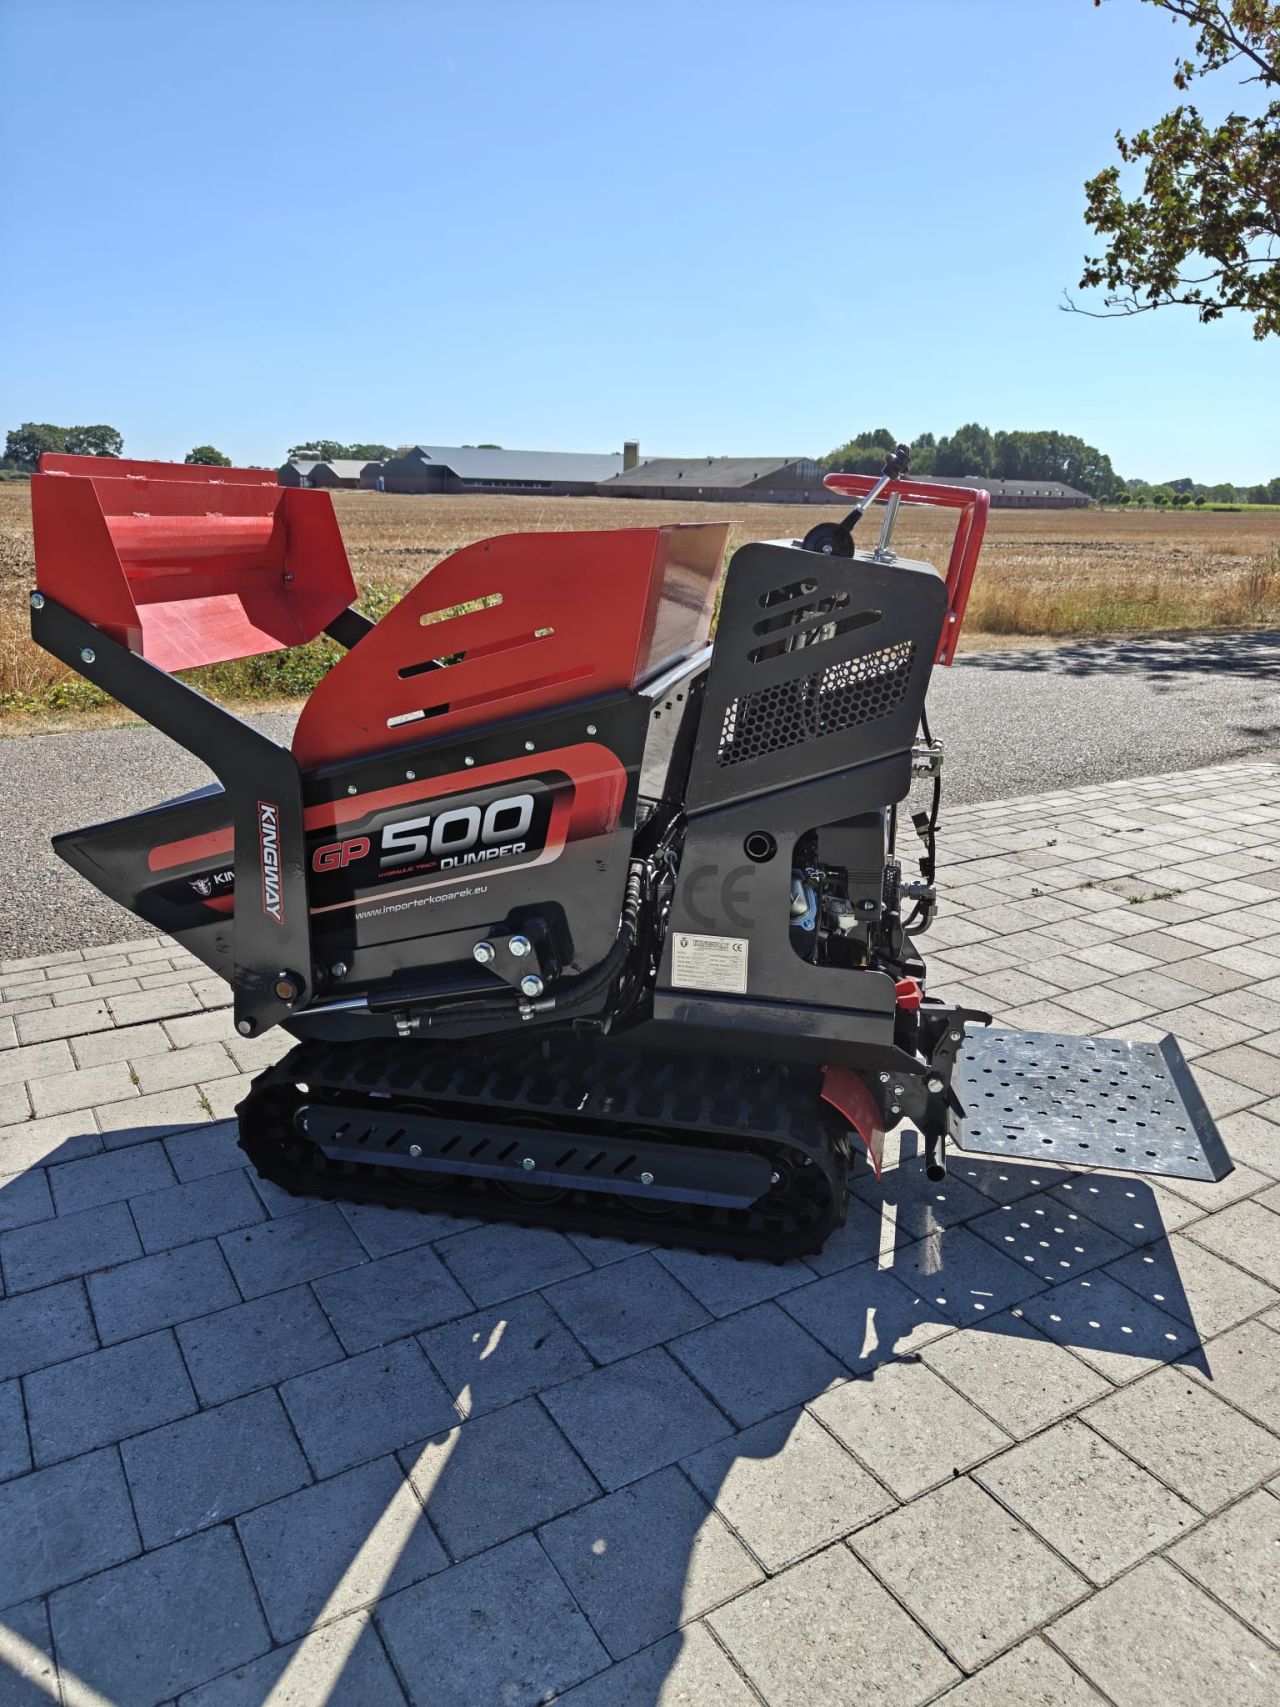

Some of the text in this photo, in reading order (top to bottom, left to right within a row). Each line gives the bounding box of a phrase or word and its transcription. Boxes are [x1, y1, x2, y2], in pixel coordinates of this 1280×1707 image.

[379, 793, 535, 869] 500
[259, 803, 282, 922] KINGWAY
[312, 836, 371, 873] GP
[440, 842, 526, 871] DUMPER
[355, 886, 488, 920] www.importerkoparek.eu
